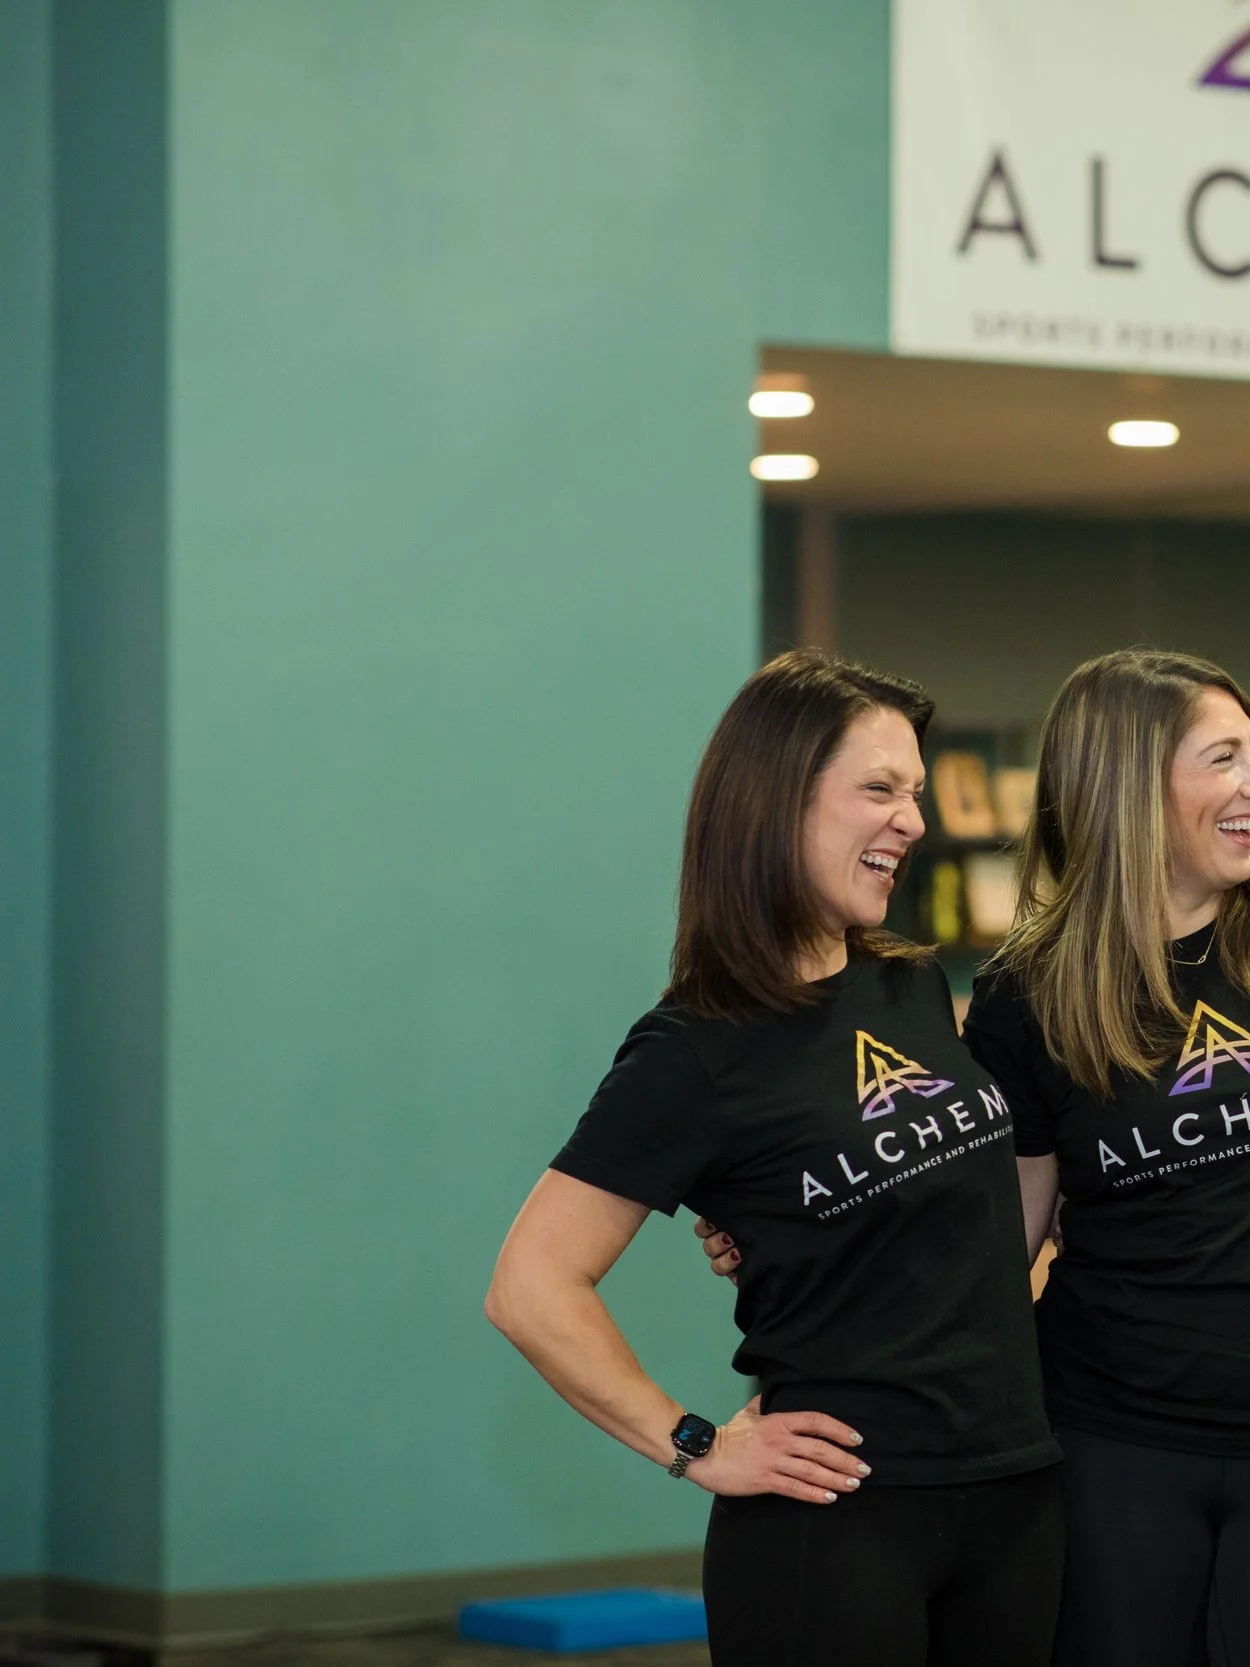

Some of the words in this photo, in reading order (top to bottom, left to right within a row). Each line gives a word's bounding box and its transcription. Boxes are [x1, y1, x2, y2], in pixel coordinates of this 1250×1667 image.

[802, 1084, 1009, 1206] ALCHEM
[1112, 1170, 1155, 1188] SPORTS
[818, 1195, 863, 1220] SPORTS
[867, 1155, 943, 1198] PERFORMANCE
[945, 1146, 966, 1160] AND
